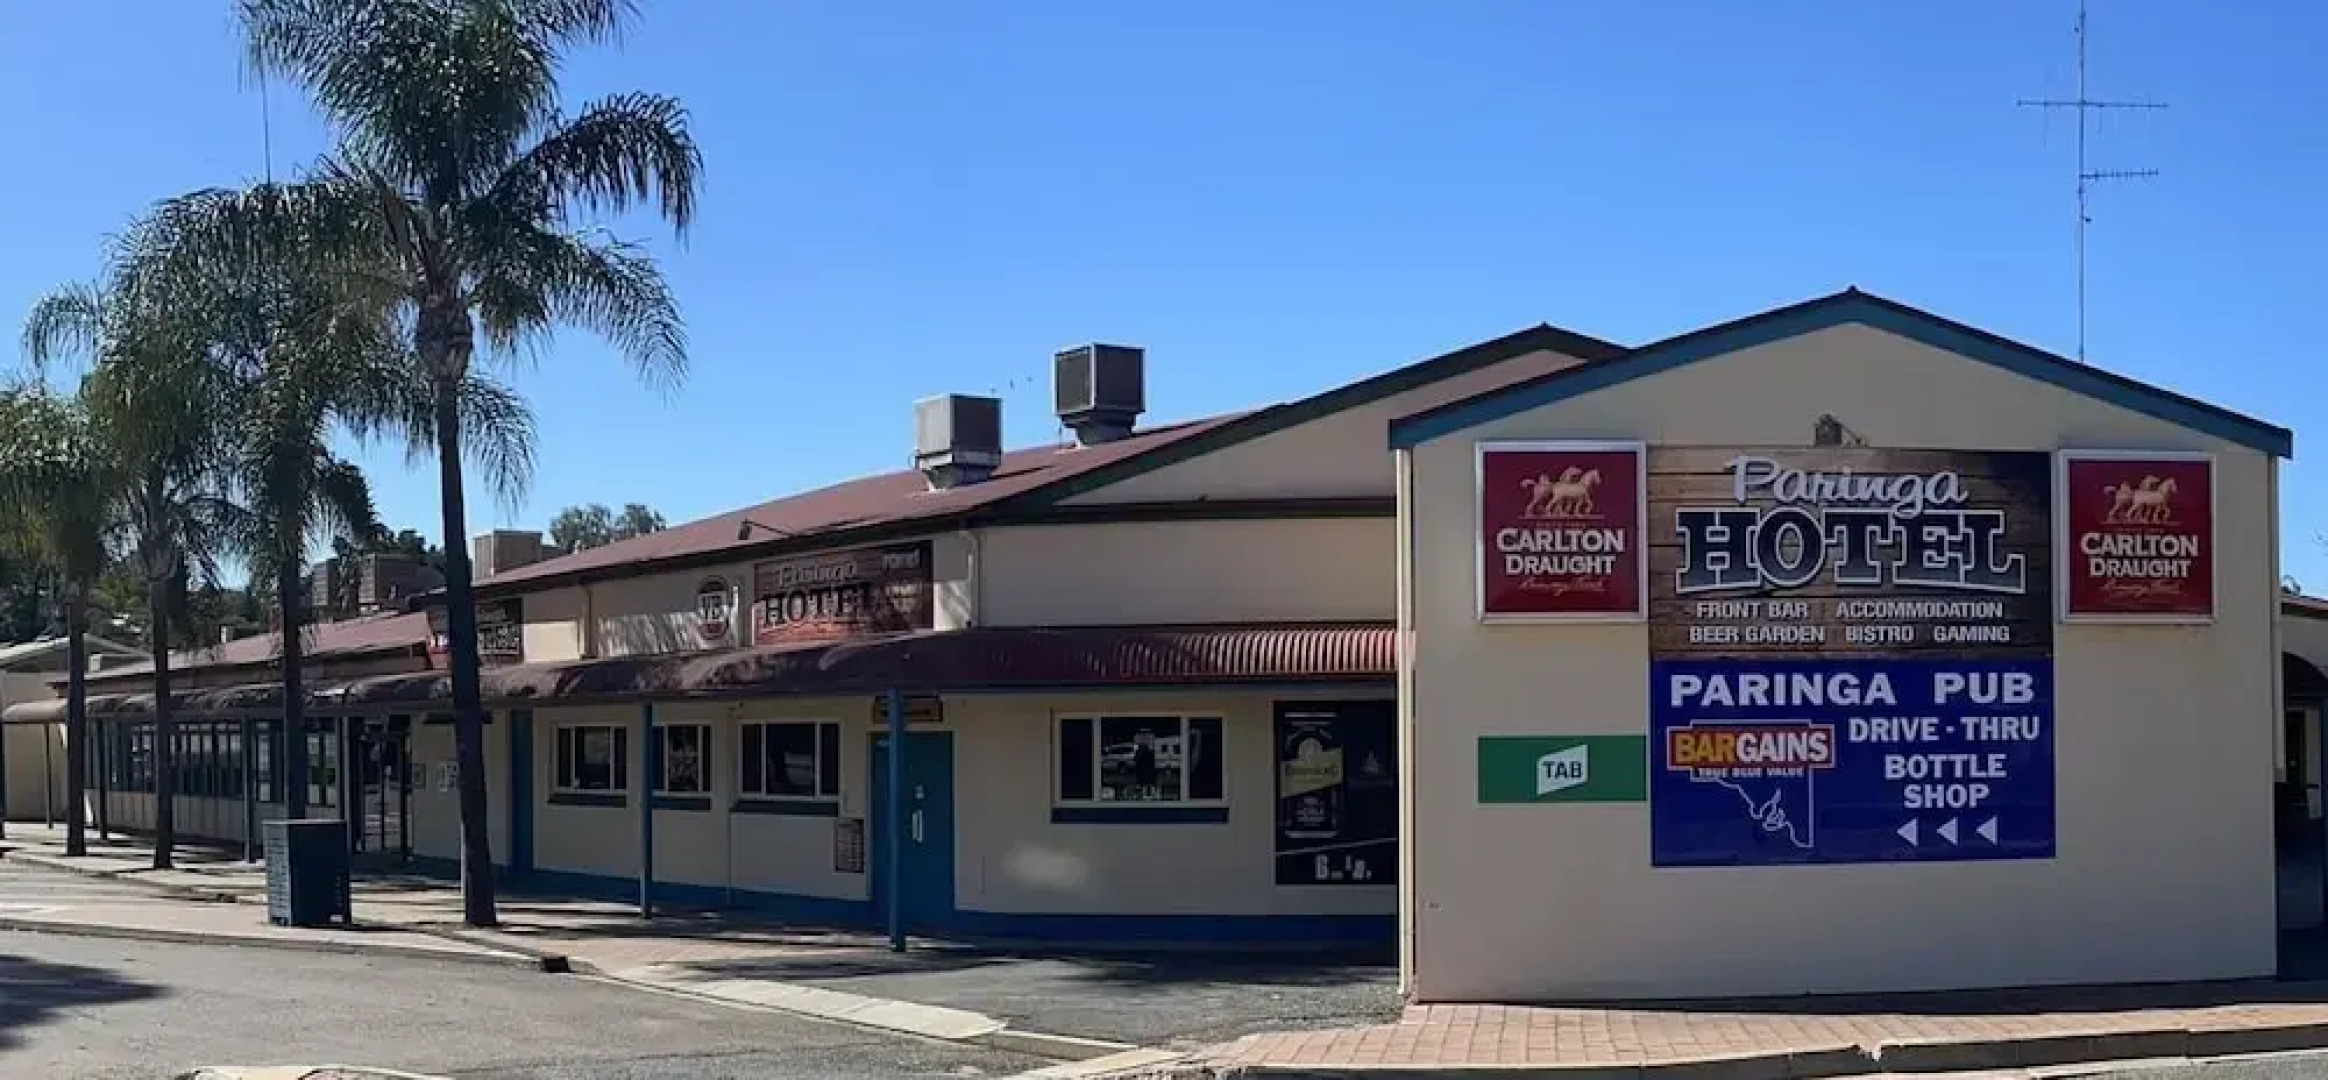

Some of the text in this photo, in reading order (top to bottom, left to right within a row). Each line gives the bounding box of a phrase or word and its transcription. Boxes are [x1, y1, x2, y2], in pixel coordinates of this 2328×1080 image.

[1724, 455, 1969, 518] Paringa
[1497, 527, 1626, 552] CARLTON
[1675, 506, 2026, 595] HOTEL
[2081, 531, 2199, 557] CARLTON
[1505, 554, 1616, 576] DRAUGHT
[2090, 558, 2191, 578] DRAUGHT
[1697, 602, 2003, 619] FRONT BAR ACCOMMODATION
[1690, 626, 2010, 643] BEER GARDEN BISTRO GAMING
[1670, 672, 2034, 707] PARINGA PUB
[1848, 716, 1940, 742] DRIVE
[1960, 715, 2040, 741] THRU
[1674, 731, 1830, 764] BARGAINS
[1541, 760, 1582, 779] TAB
[1884, 754, 2008, 780] BOTTLE
[1903, 784, 1990, 809] SHOP
